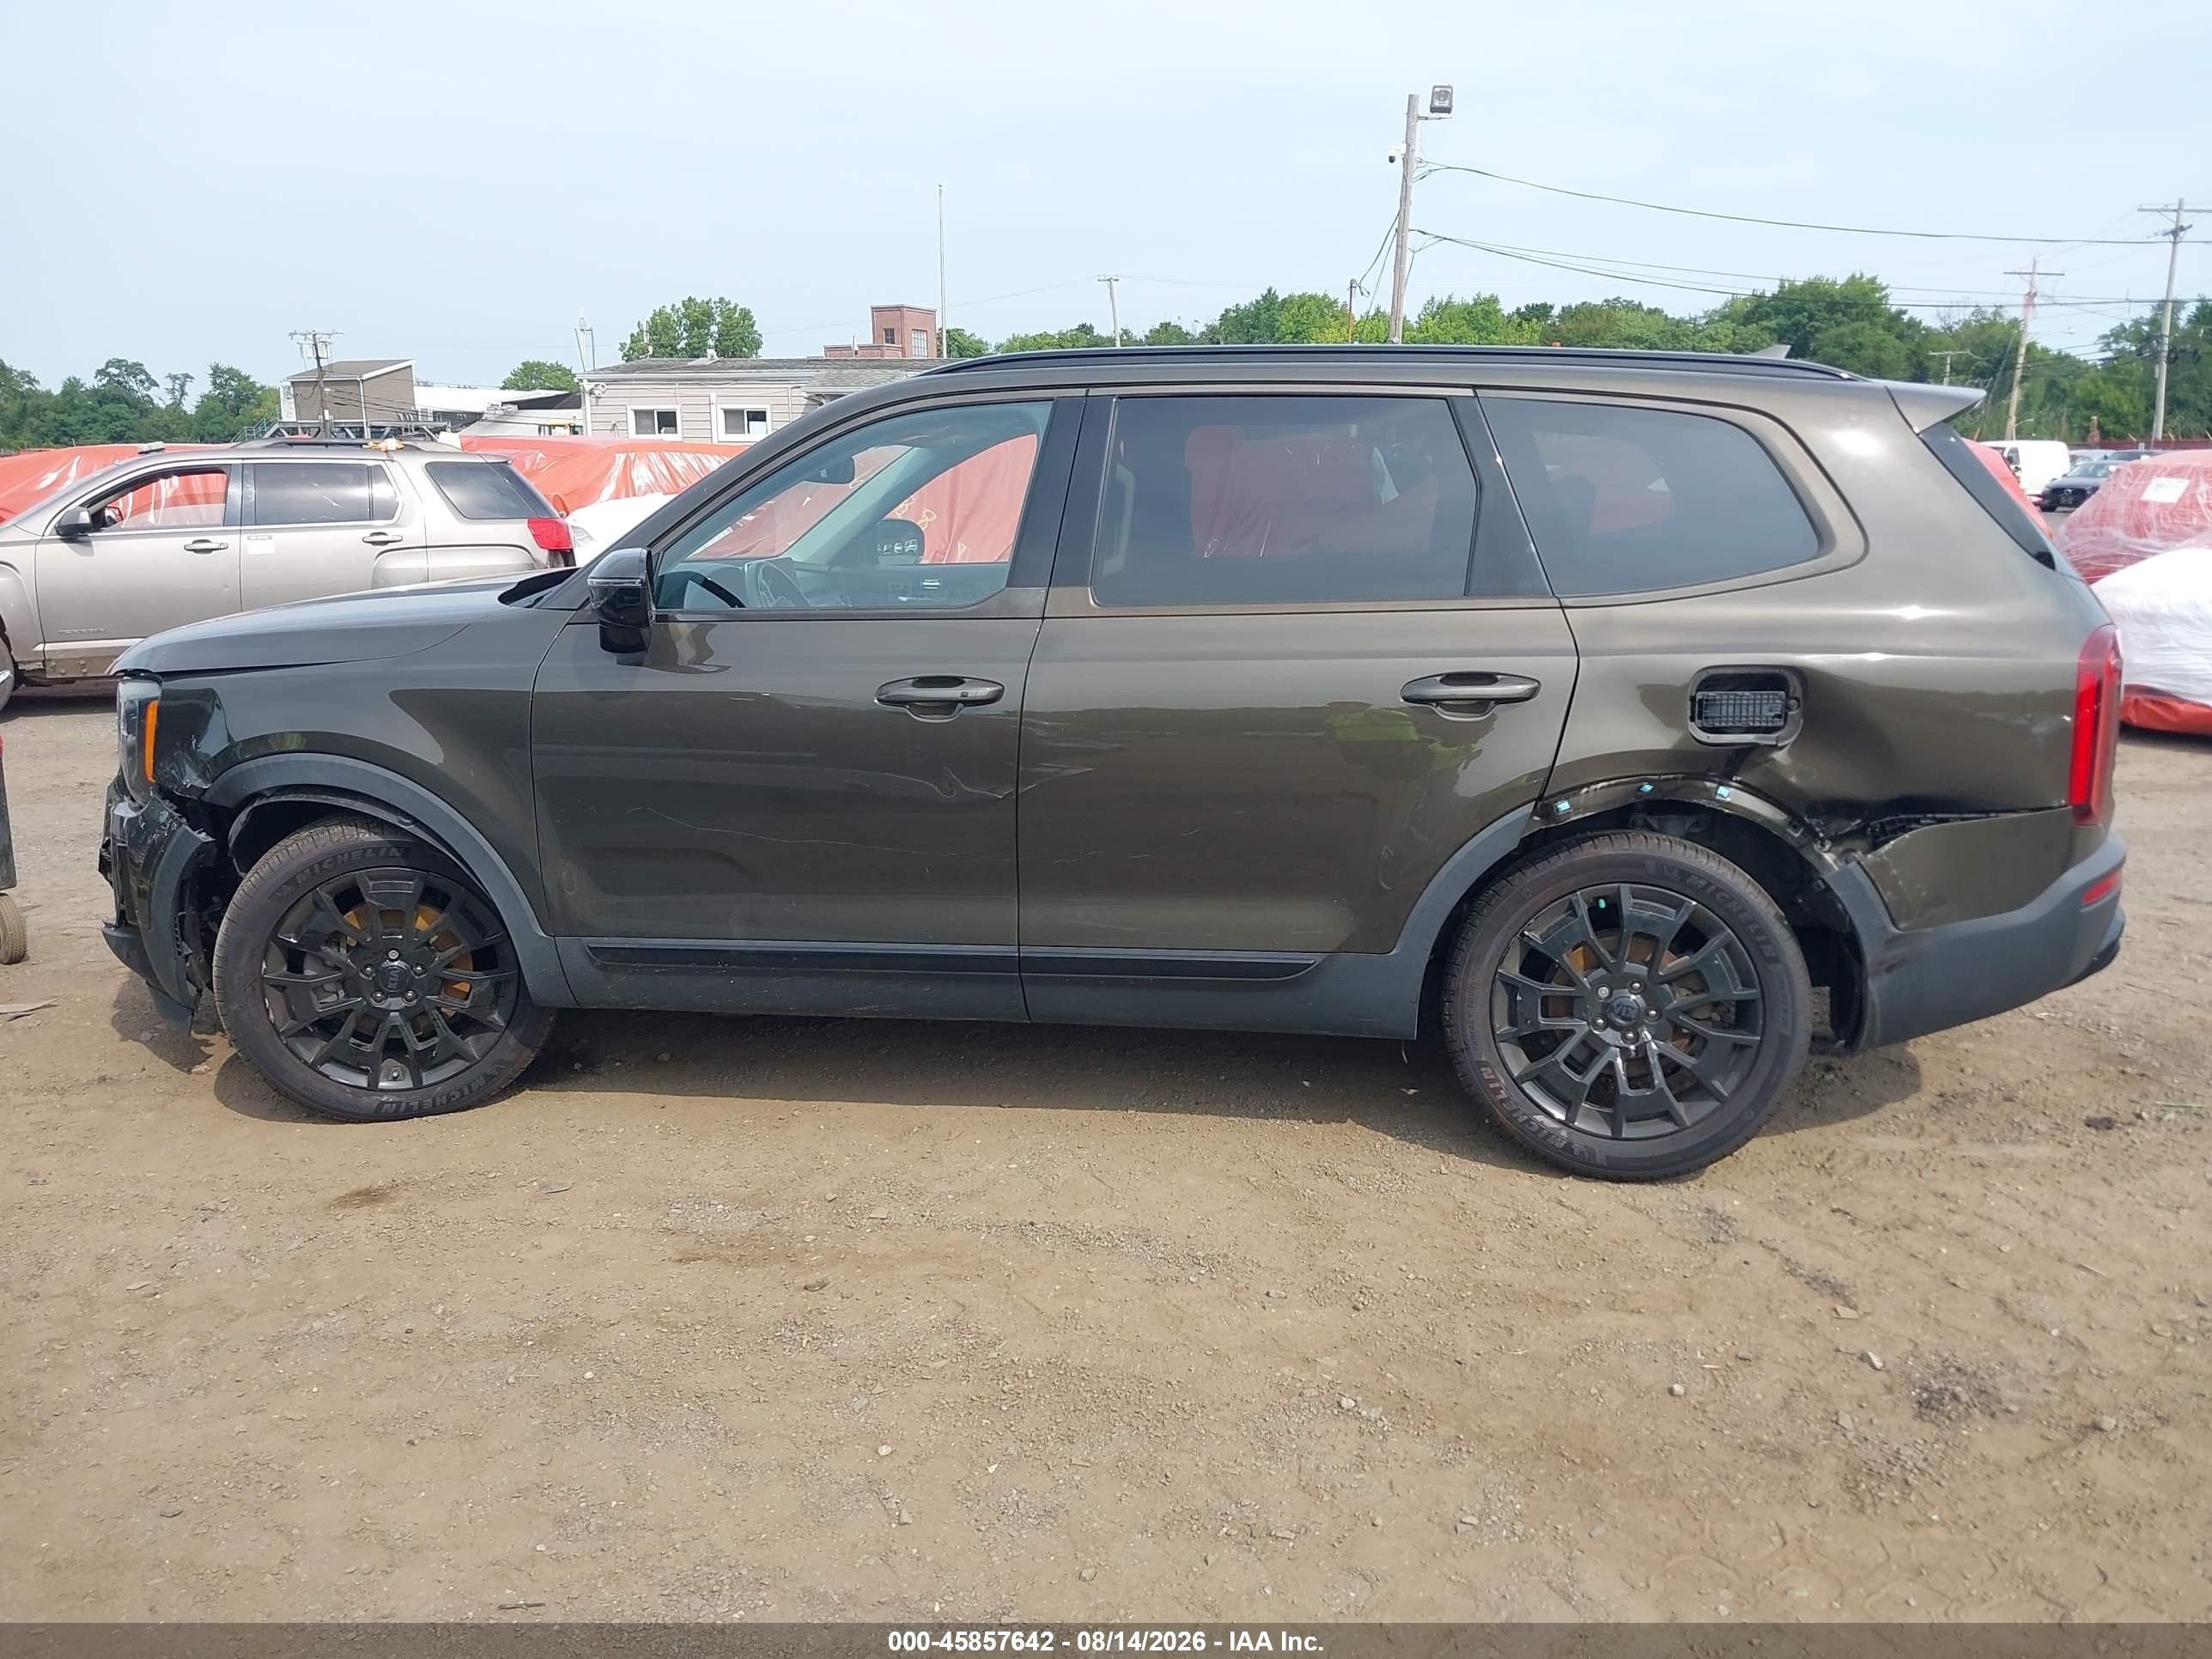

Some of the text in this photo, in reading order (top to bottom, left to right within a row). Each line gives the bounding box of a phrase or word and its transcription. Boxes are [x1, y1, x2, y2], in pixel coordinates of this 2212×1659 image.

[295, 846, 407, 885] MICHELIN
[1686, 874, 1778, 958] MICHELIN
[380, 1073, 487, 1115] MICHELIN
[1479, 1066, 1569, 1149] MICHELIN
